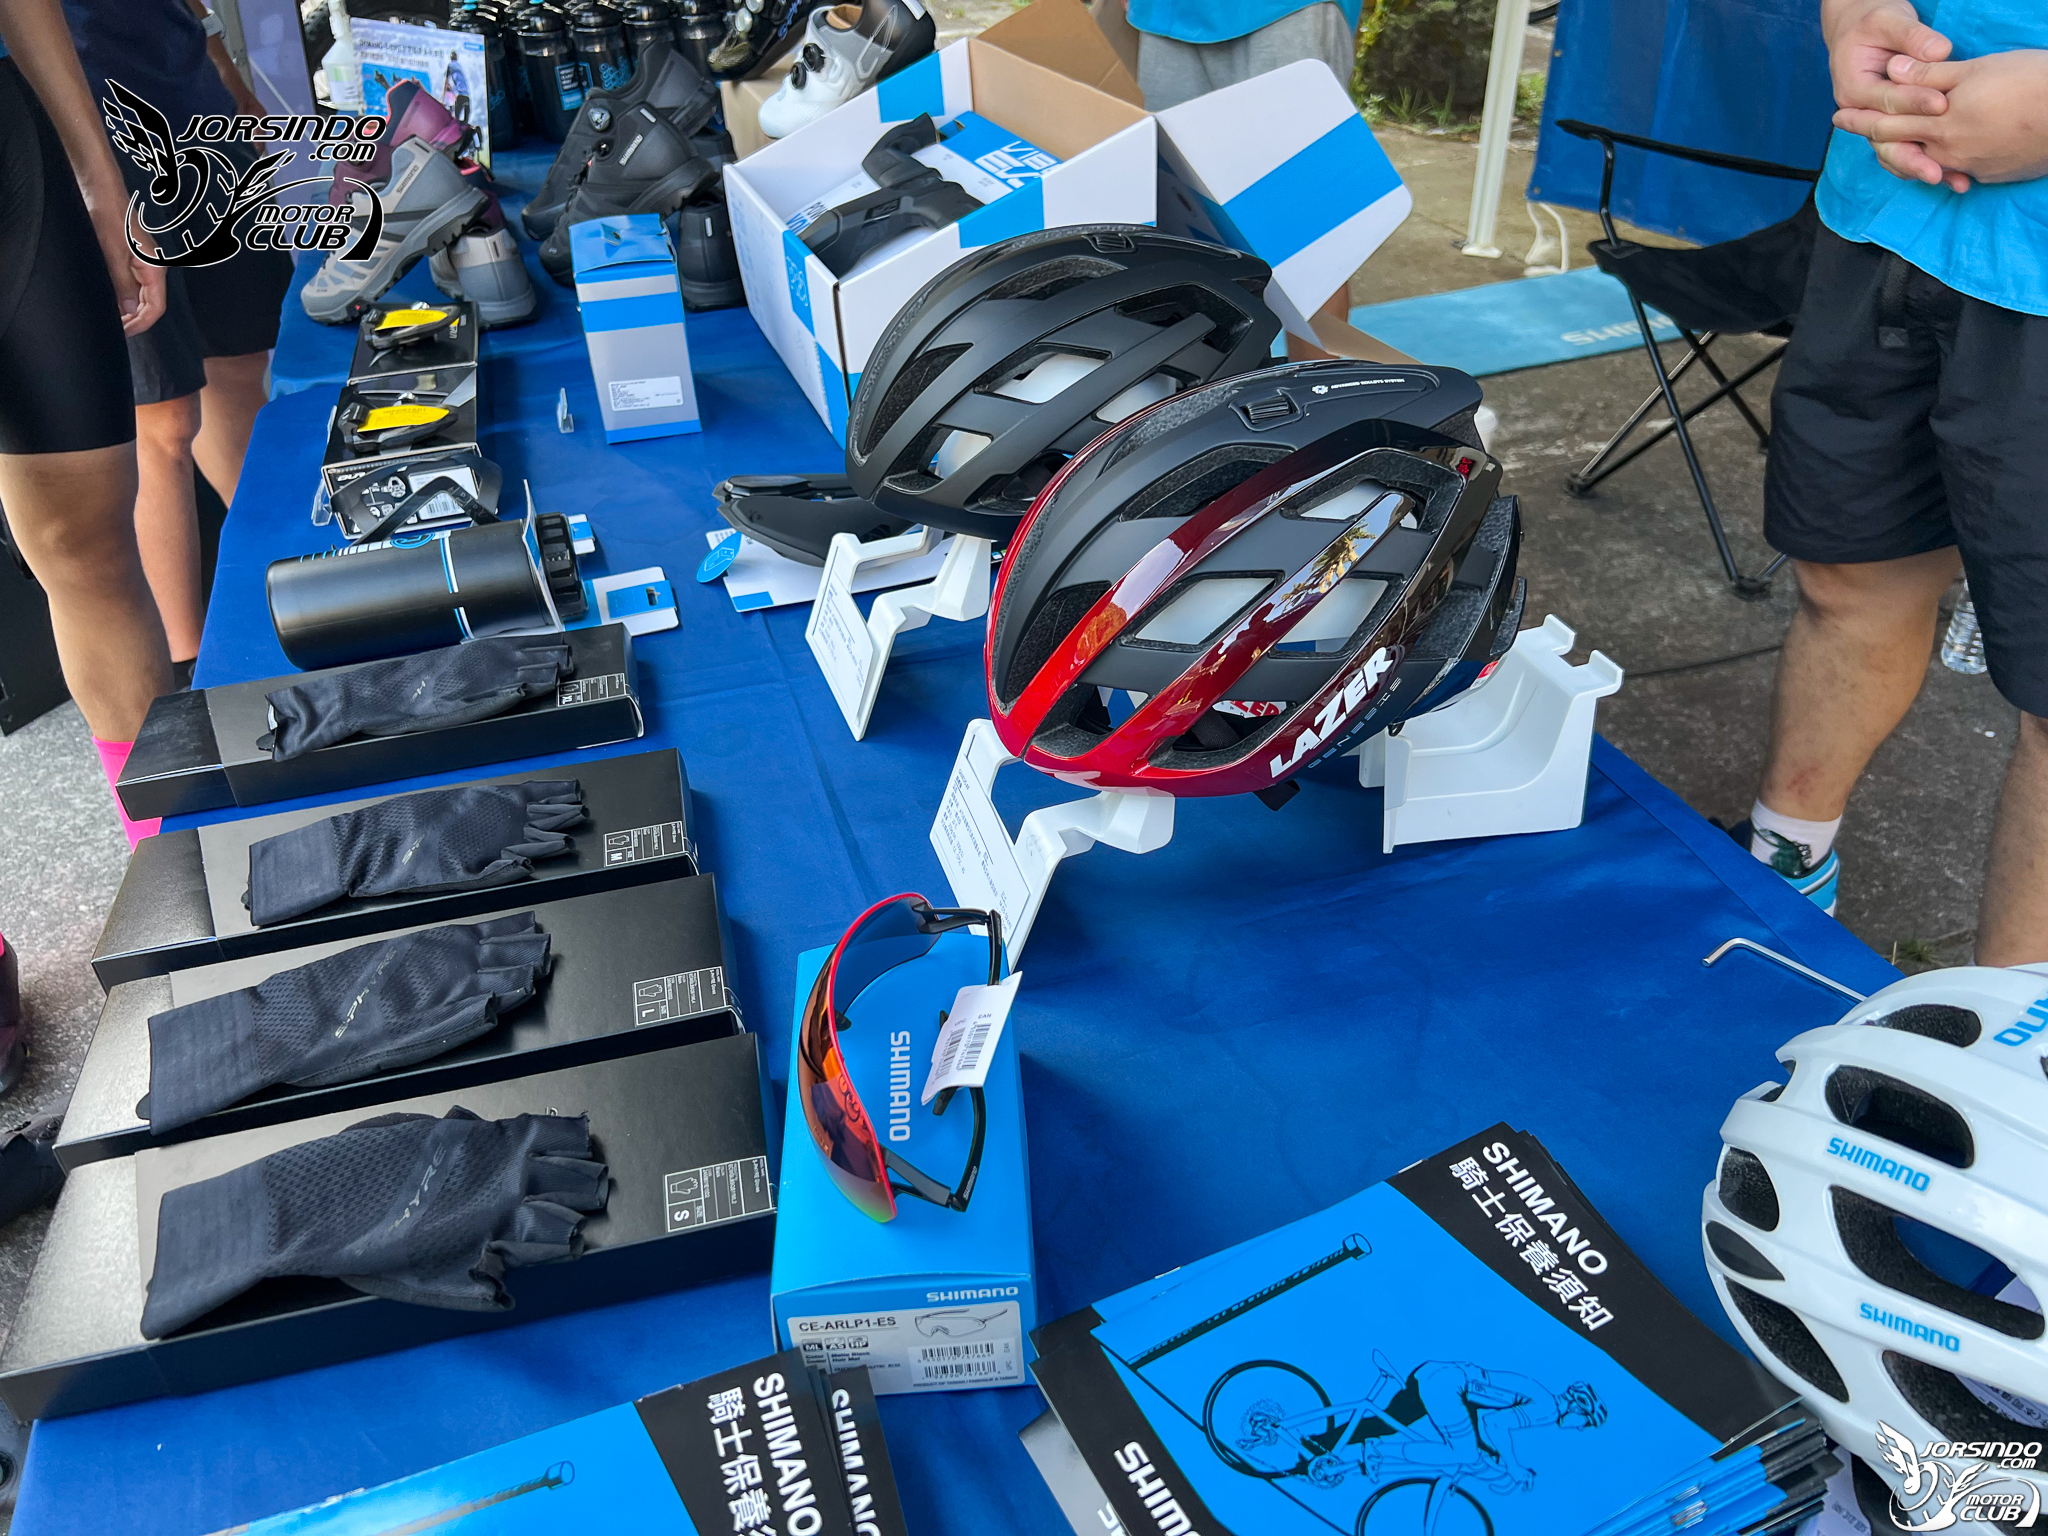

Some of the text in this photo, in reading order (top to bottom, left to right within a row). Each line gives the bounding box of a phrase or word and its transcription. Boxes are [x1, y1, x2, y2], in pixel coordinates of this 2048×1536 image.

[619, 134, 643, 166] SHIMANO
[396, 165, 420, 194] SHIMANO
[1270, 647, 1394, 778] LAZER
[1308, 677, 1401, 769] GENESIS
[610, 852, 623, 861] M
[642, 1008, 655, 1018] L
[889, 1030, 910, 1141] SHIMANO
[1827, 1137, 1931, 1192] SHIMANO
[963, 1165, 978, 1200] SHIMANO
[674, 1210, 690, 1222] S
[1482, 1141, 1608, 1276] SHIMANO
[1448, 1156, 1614, 1332] 騎士保養須知
[927, 1287, 1019, 1303] SHIMANO
[799, 1316, 897, 1332] CE-ARLP1-ES
[1860, 1302, 1960, 1352] SHIMANO
[805, 1340, 867, 1351] ML AS HP
[753, 1372, 823, 1536] SHIMANO
